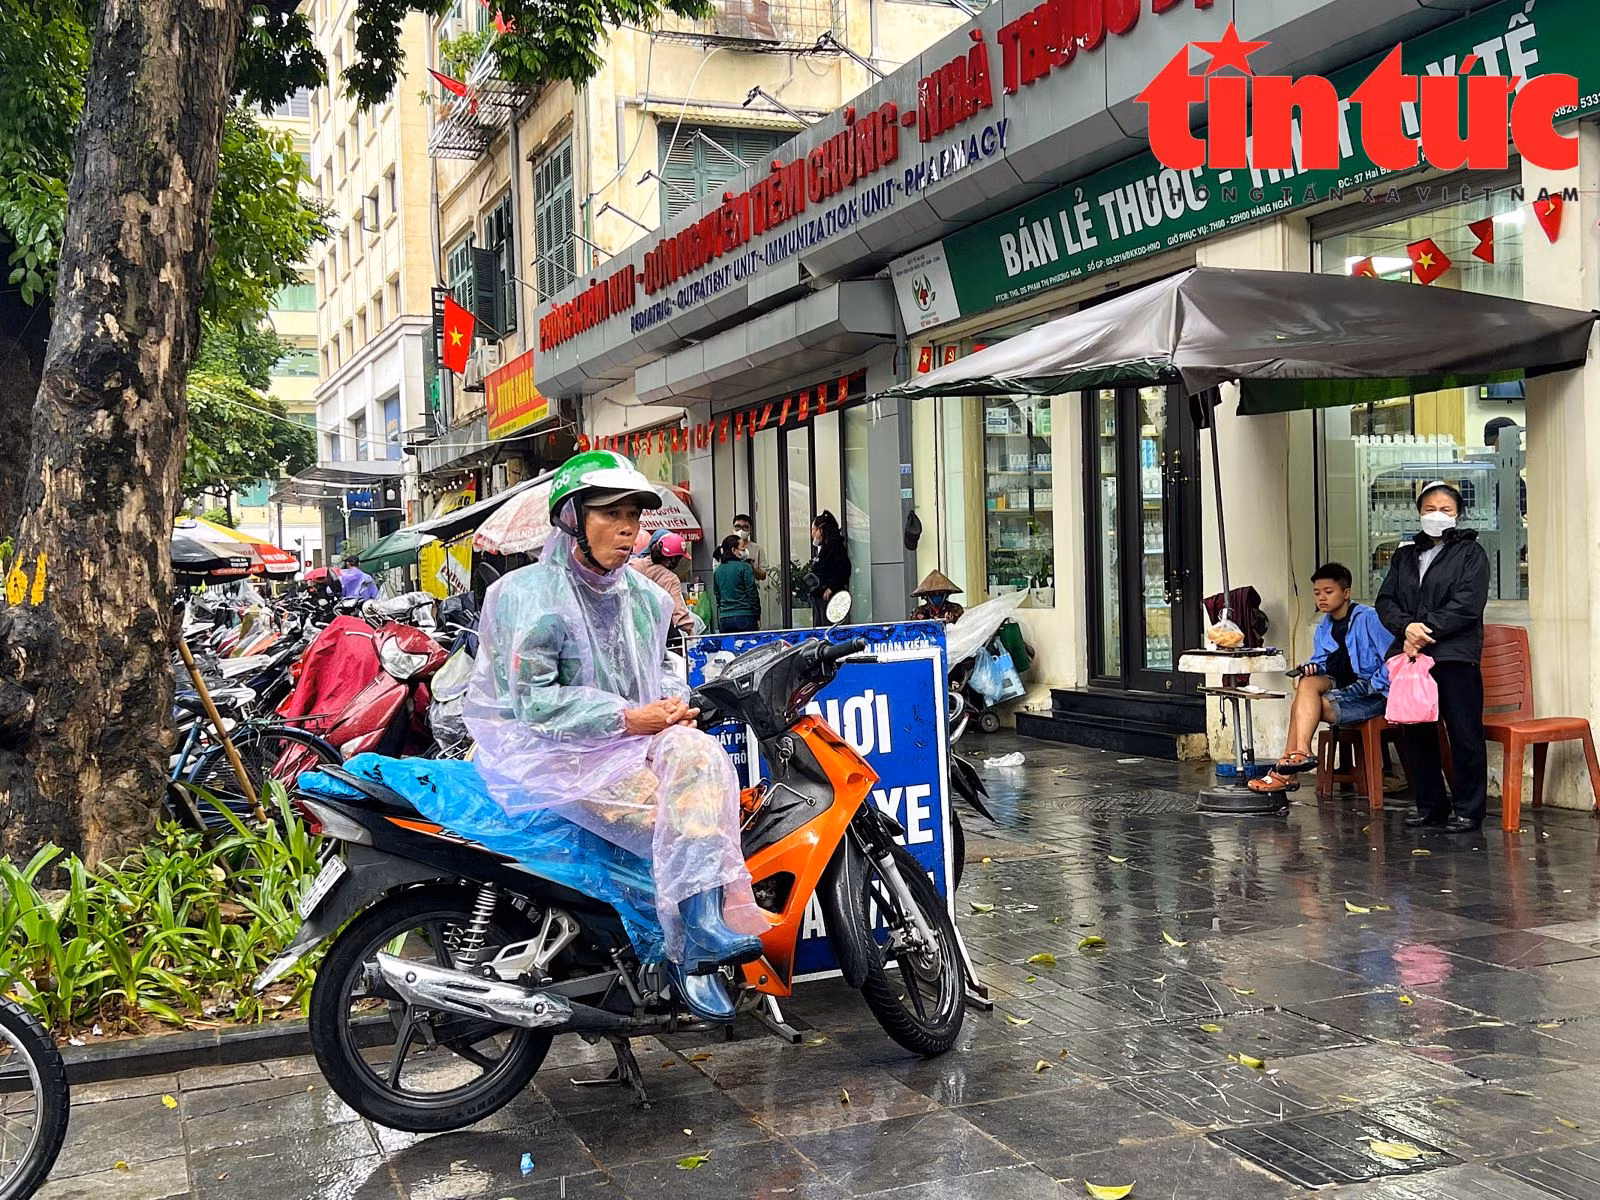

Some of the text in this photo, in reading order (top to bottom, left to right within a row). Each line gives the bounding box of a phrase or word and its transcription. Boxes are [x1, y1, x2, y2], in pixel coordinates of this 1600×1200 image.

[1579, 91, 1600, 109] 533
[609, 264, 636, 316] NHI
[750, 159, 806, 236] TIÊM
[807, 102, 899, 204] CHỦNG
[918, 28, 993, 143] NHÀ
[1353, 173, 1364, 184] 37
[630, 297, 673, 335] PEDIATRIC
[677, 264, 731, 311] OUTPATIENT
[733, 250, 759, 282] UNIT
[765, 199, 860, 267] IMMUNIZATION
[861, 178, 897, 219] UNIT
[904, 117, 1010, 197] PHARMACY
[1000, 216, 1059, 278] BÁN
[1058, 187, 1099, 256] LẺ
[1179, 229, 1198, 243] PHỤC
[1197, 225, 1210, 237] VỤ:
[1229, 210, 1251, 225] 22H00
[1249, 203, 1272, 218] HÀNG
[639, 517, 689, 528] SINH VIÊN
[871, 783, 935, 846] XE
